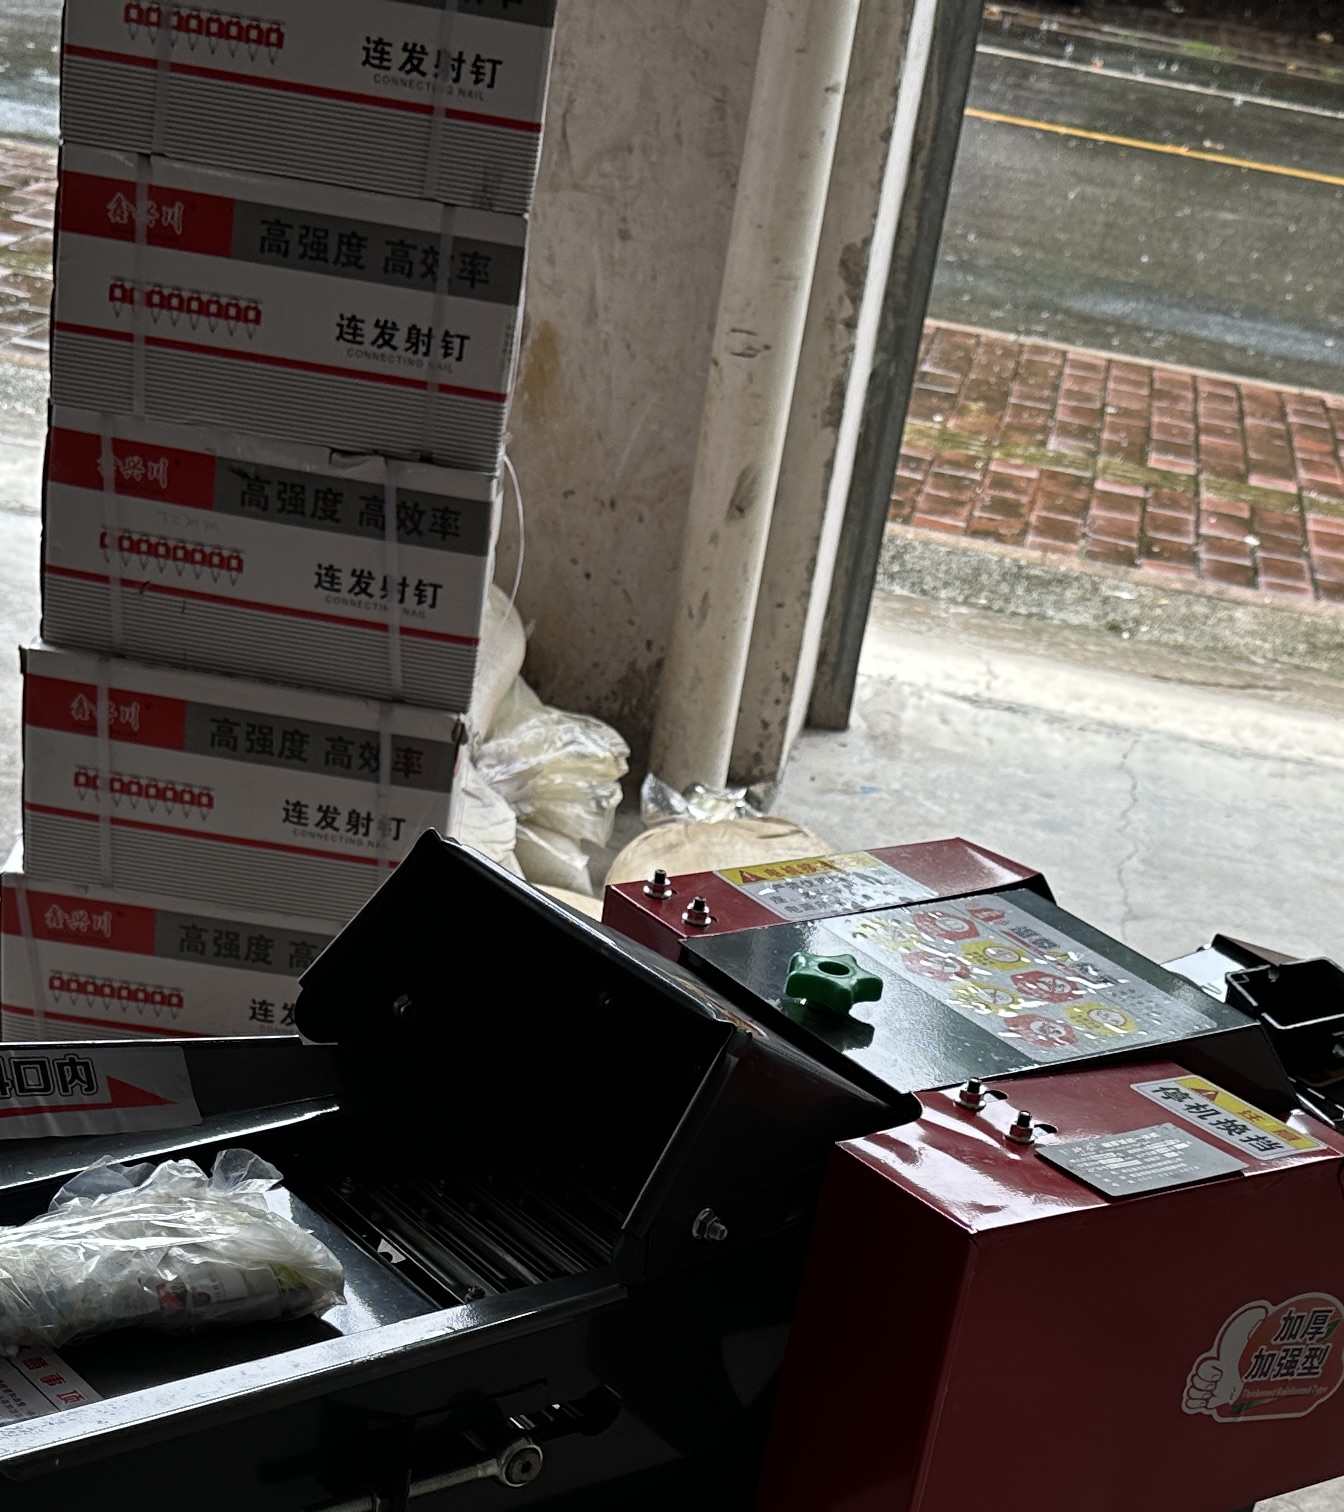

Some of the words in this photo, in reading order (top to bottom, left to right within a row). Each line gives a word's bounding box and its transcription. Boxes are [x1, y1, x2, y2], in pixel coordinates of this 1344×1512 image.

[361, 36, 503, 90] 连发射钉
[458, 86, 484, 101] NAIL
[259, 217, 365, 272] 高强度
[382, 238, 492, 290] 高效率
[335, 313, 471, 363] 连发射钉
[346, 348, 424, 369] CONNECTING
[240, 475, 344, 524] 高强度
[358, 493, 462, 541] 高效率
[314, 563, 444, 610] 连发射钉
[325, 594, 394, 612] CONNECTIN
[402, 606, 426, 620] NAIL
[210, 717, 310, 763] 高强度
[324, 734, 425, 779] 高效率
[282, 799, 406, 842] 连发射钉
[293, 828, 364, 847] CONNECTING
[179, 923, 274, 967] 高强度
[249, 999, 297, 1026] 连发
[1152, 1084, 1286, 1153] 停机换挡
[1273, 1307, 1336, 1343] 加厚
[16, 1347, 87, 1406] 意事项
[1243, 1344, 1331, 1381] 加强型
